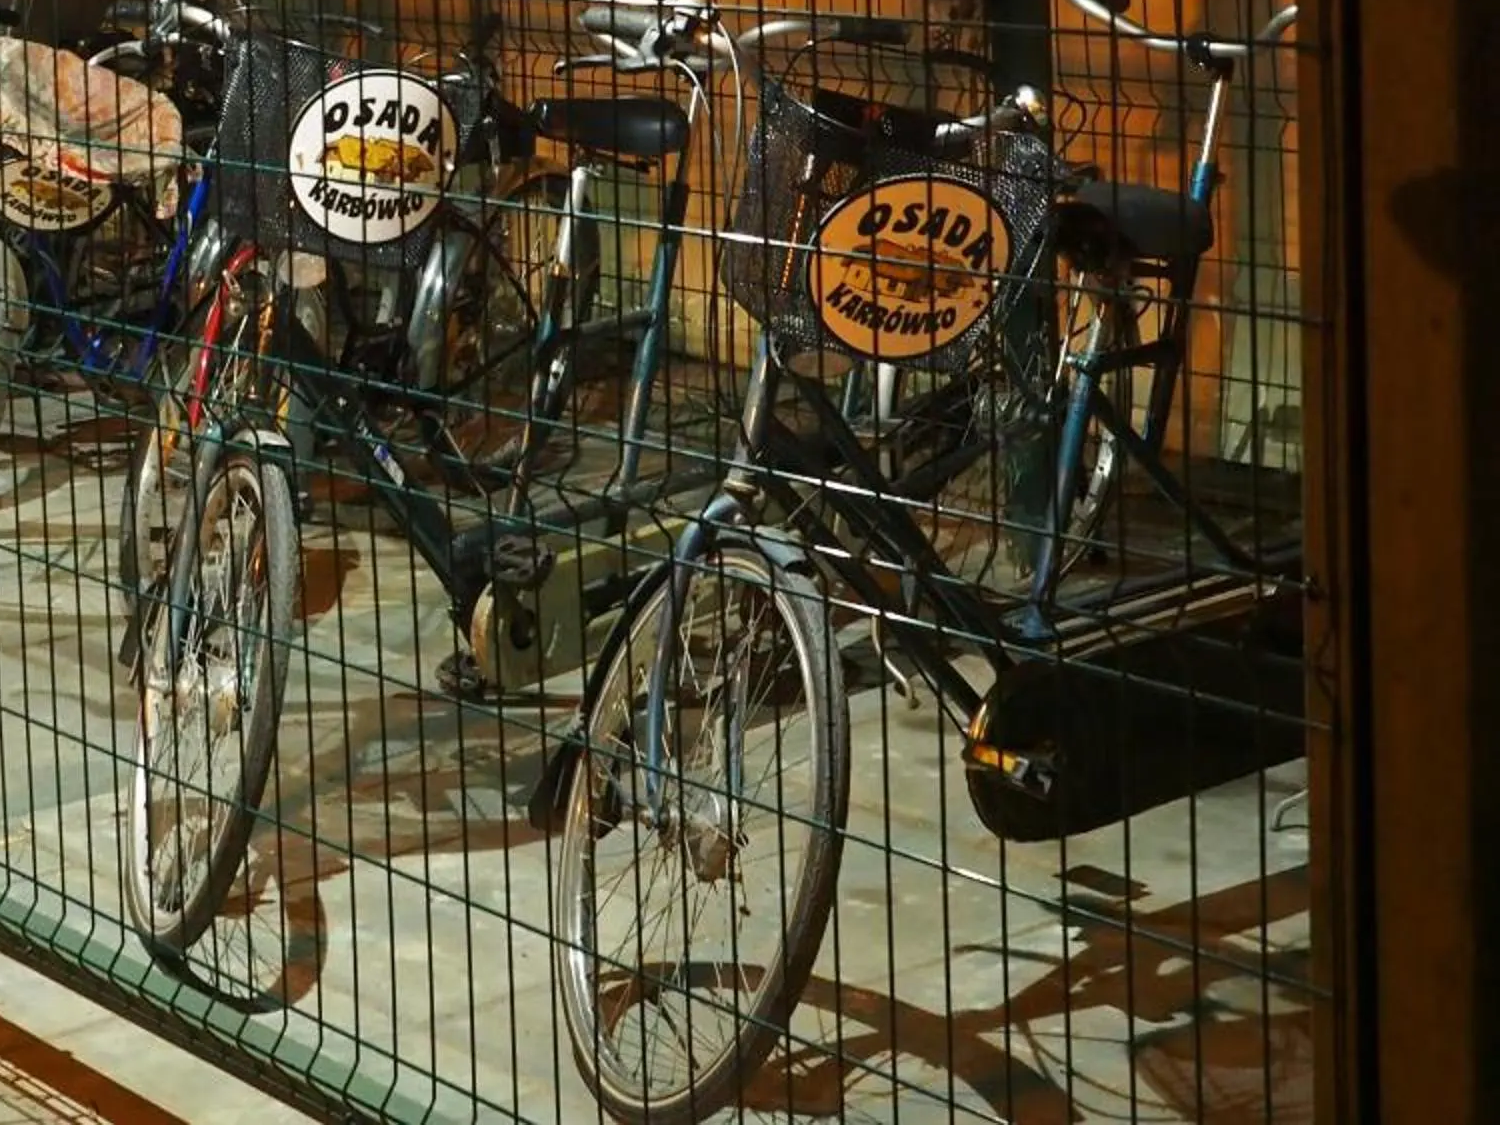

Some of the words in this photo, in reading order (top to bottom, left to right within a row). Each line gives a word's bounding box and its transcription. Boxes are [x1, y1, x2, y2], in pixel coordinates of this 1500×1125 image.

[325, 98, 442, 157] OSADA
[22, 166, 102, 201] OSADA
[308, 178, 424, 221] KARBÓWKO
[857, 202, 993, 272] OSADA
[825, 282, 957, 336] KARBÓWKO
